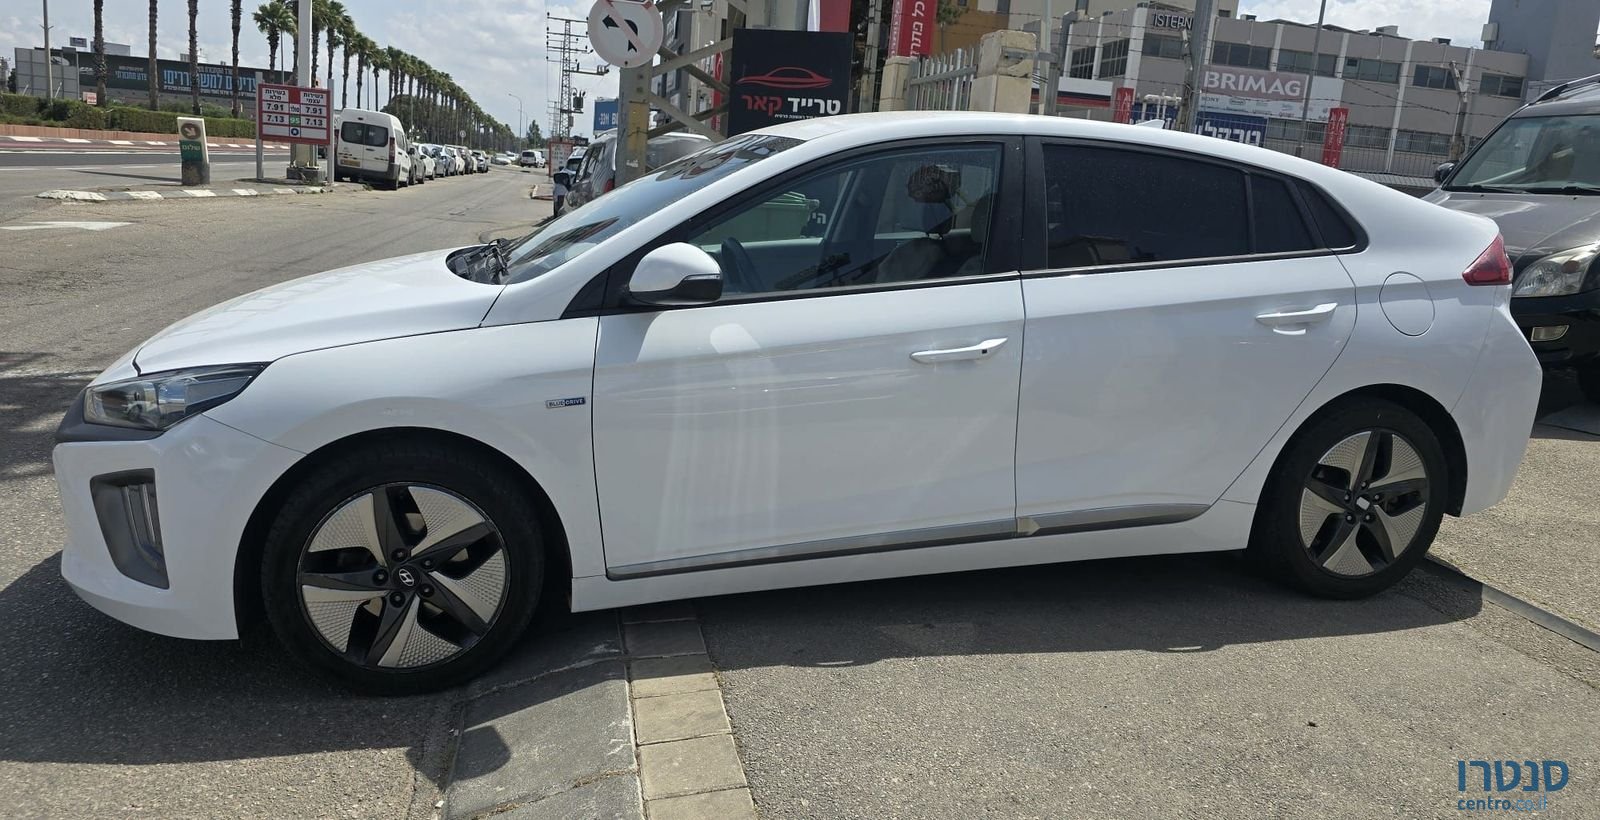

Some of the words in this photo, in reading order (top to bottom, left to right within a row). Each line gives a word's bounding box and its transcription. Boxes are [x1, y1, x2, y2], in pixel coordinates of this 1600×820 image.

[911, 1, 925, 17] כל
[1203, 71, 1301, 96] BRIMAG
[267, 103, 284, 111] 7.91
[305, 107, 323, 115] 7.91
[742, 95, 784, 116] קאר
[787, 97, 841, 115] טרייד
[305, 118, 323, 126] 7.13
